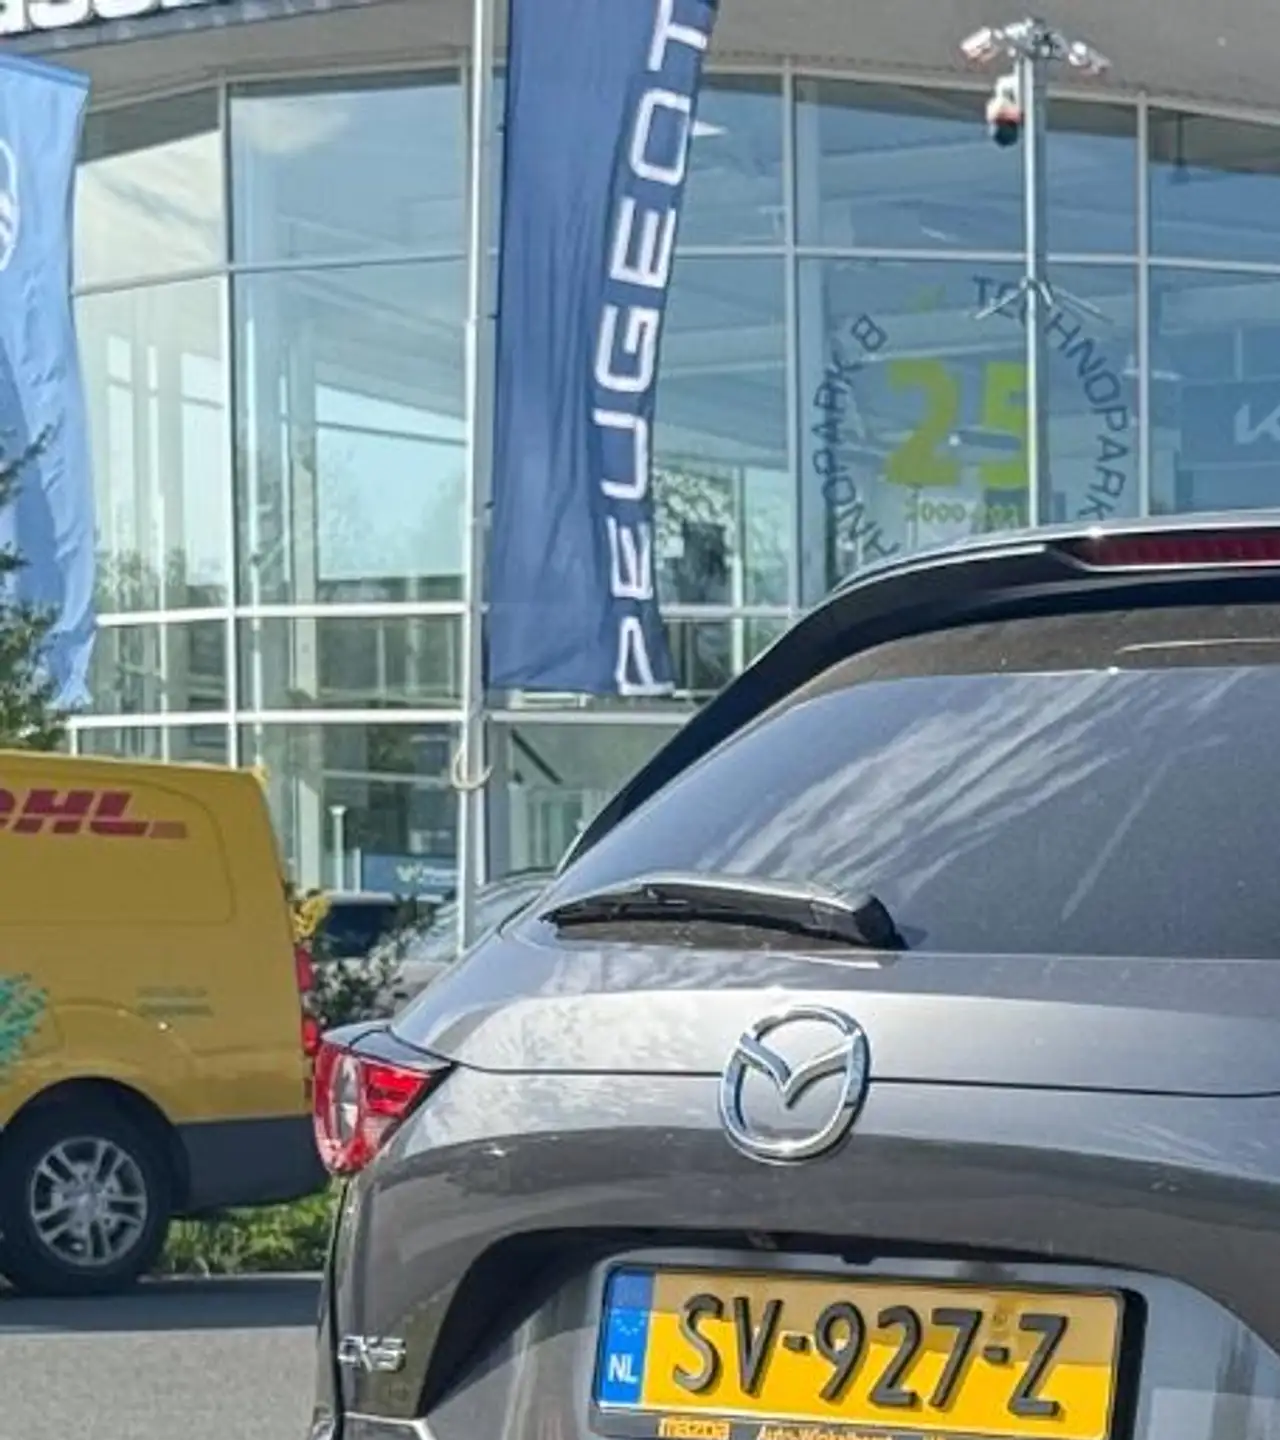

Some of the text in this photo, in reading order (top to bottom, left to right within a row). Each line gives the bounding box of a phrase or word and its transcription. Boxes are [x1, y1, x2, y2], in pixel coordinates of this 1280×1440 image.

[594, 0, 709, 696] PEUGEOT
[0, 787, 151, 838] HL
[606, 1292, 1069, 1418] NL SV-927-Z
